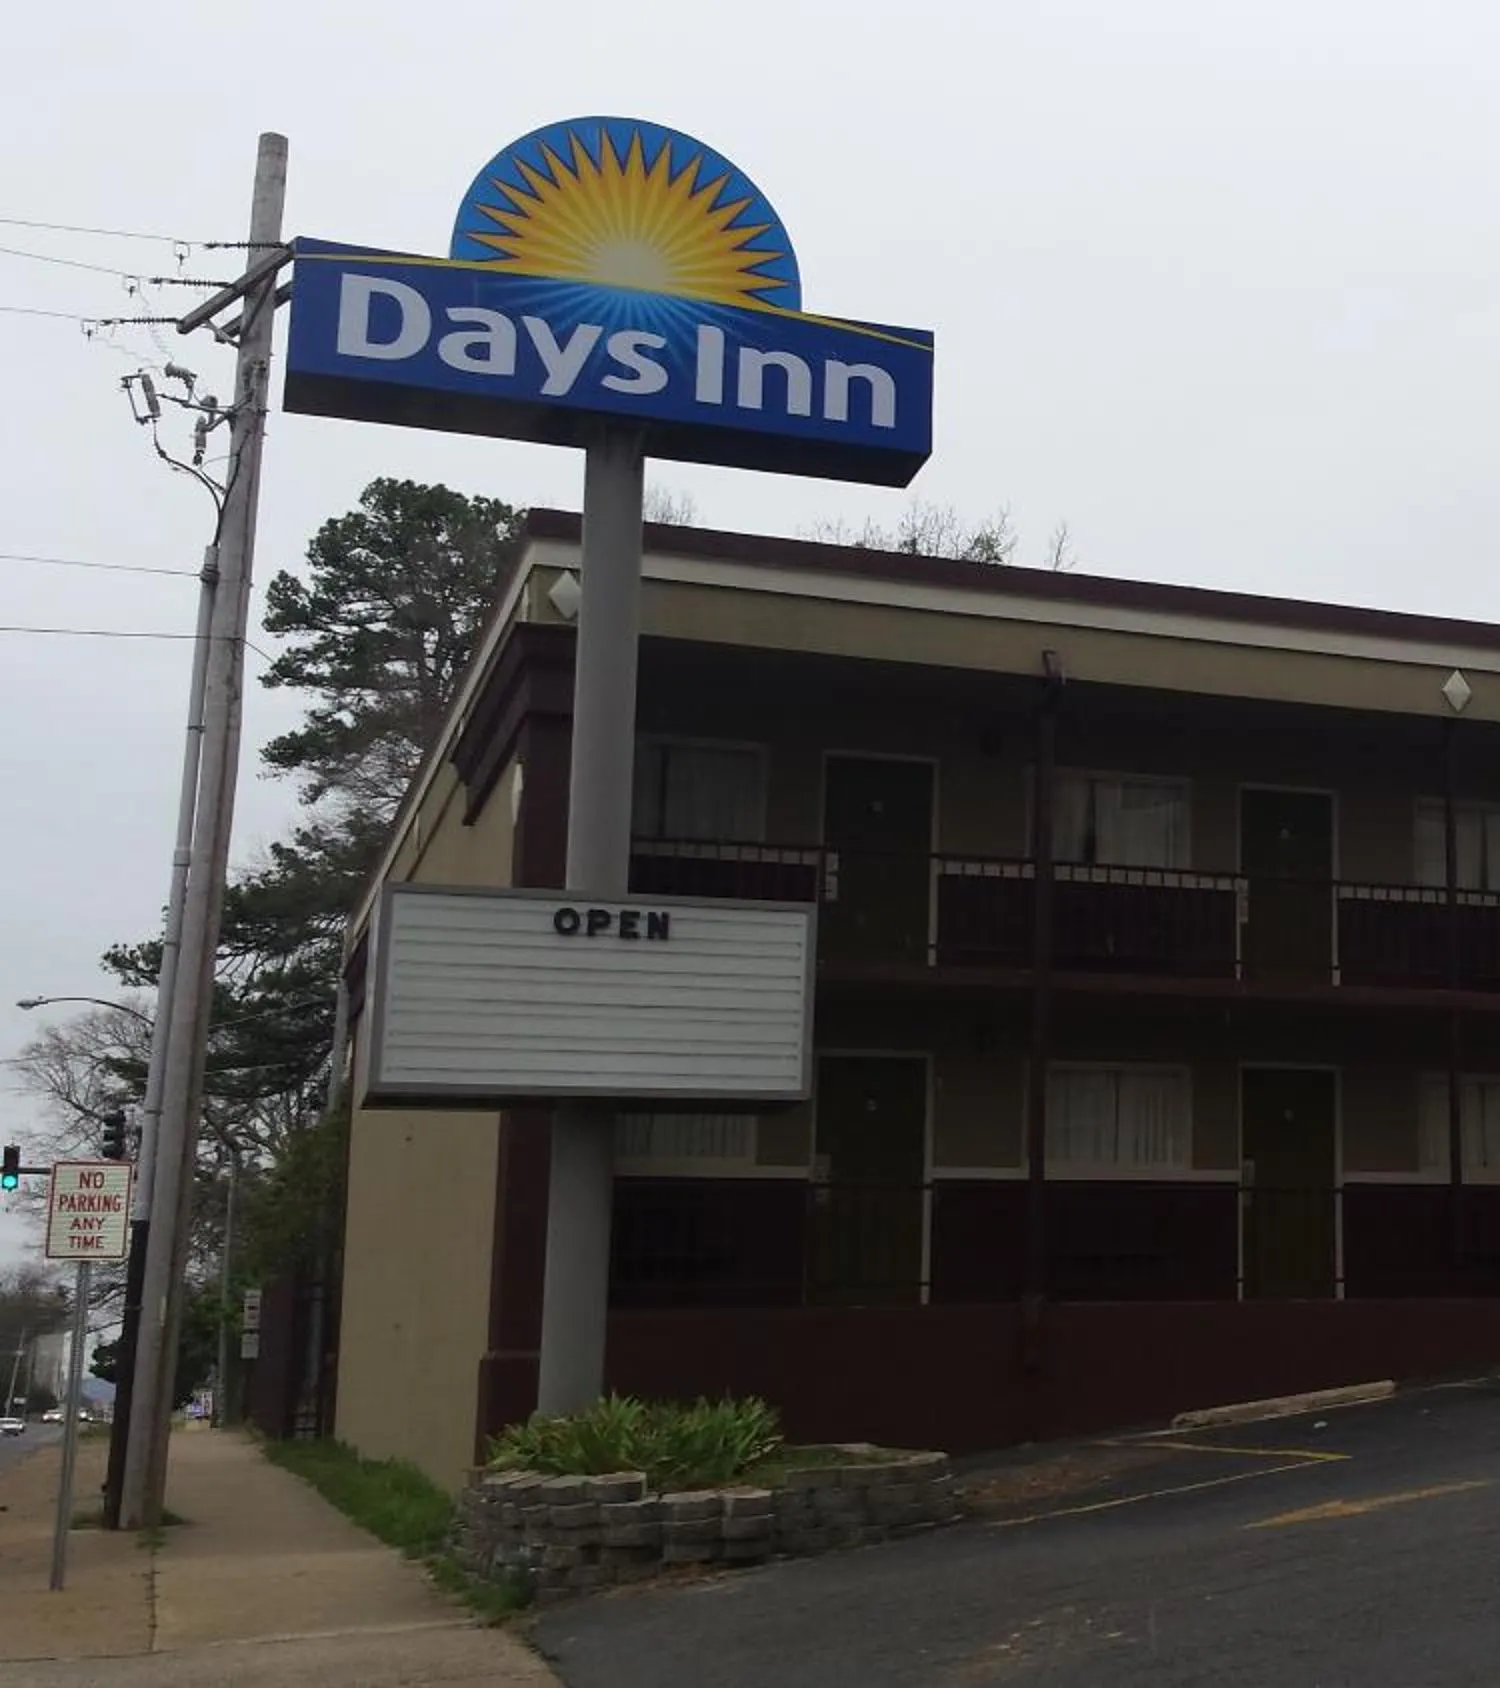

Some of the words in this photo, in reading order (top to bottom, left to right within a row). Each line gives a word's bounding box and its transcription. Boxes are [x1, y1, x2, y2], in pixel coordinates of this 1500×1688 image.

[336, 273, 668, 396] Days
[694, 323, 897, 428] Inn
[553, 907, 671, 941] OPEN
[79, 1171, 105, 1189] NO
[58, 1193, 121, 1213] PARKING
[70, 1217, 105, 1231] ANY
[68, 1235, 105, 1249] TIME
